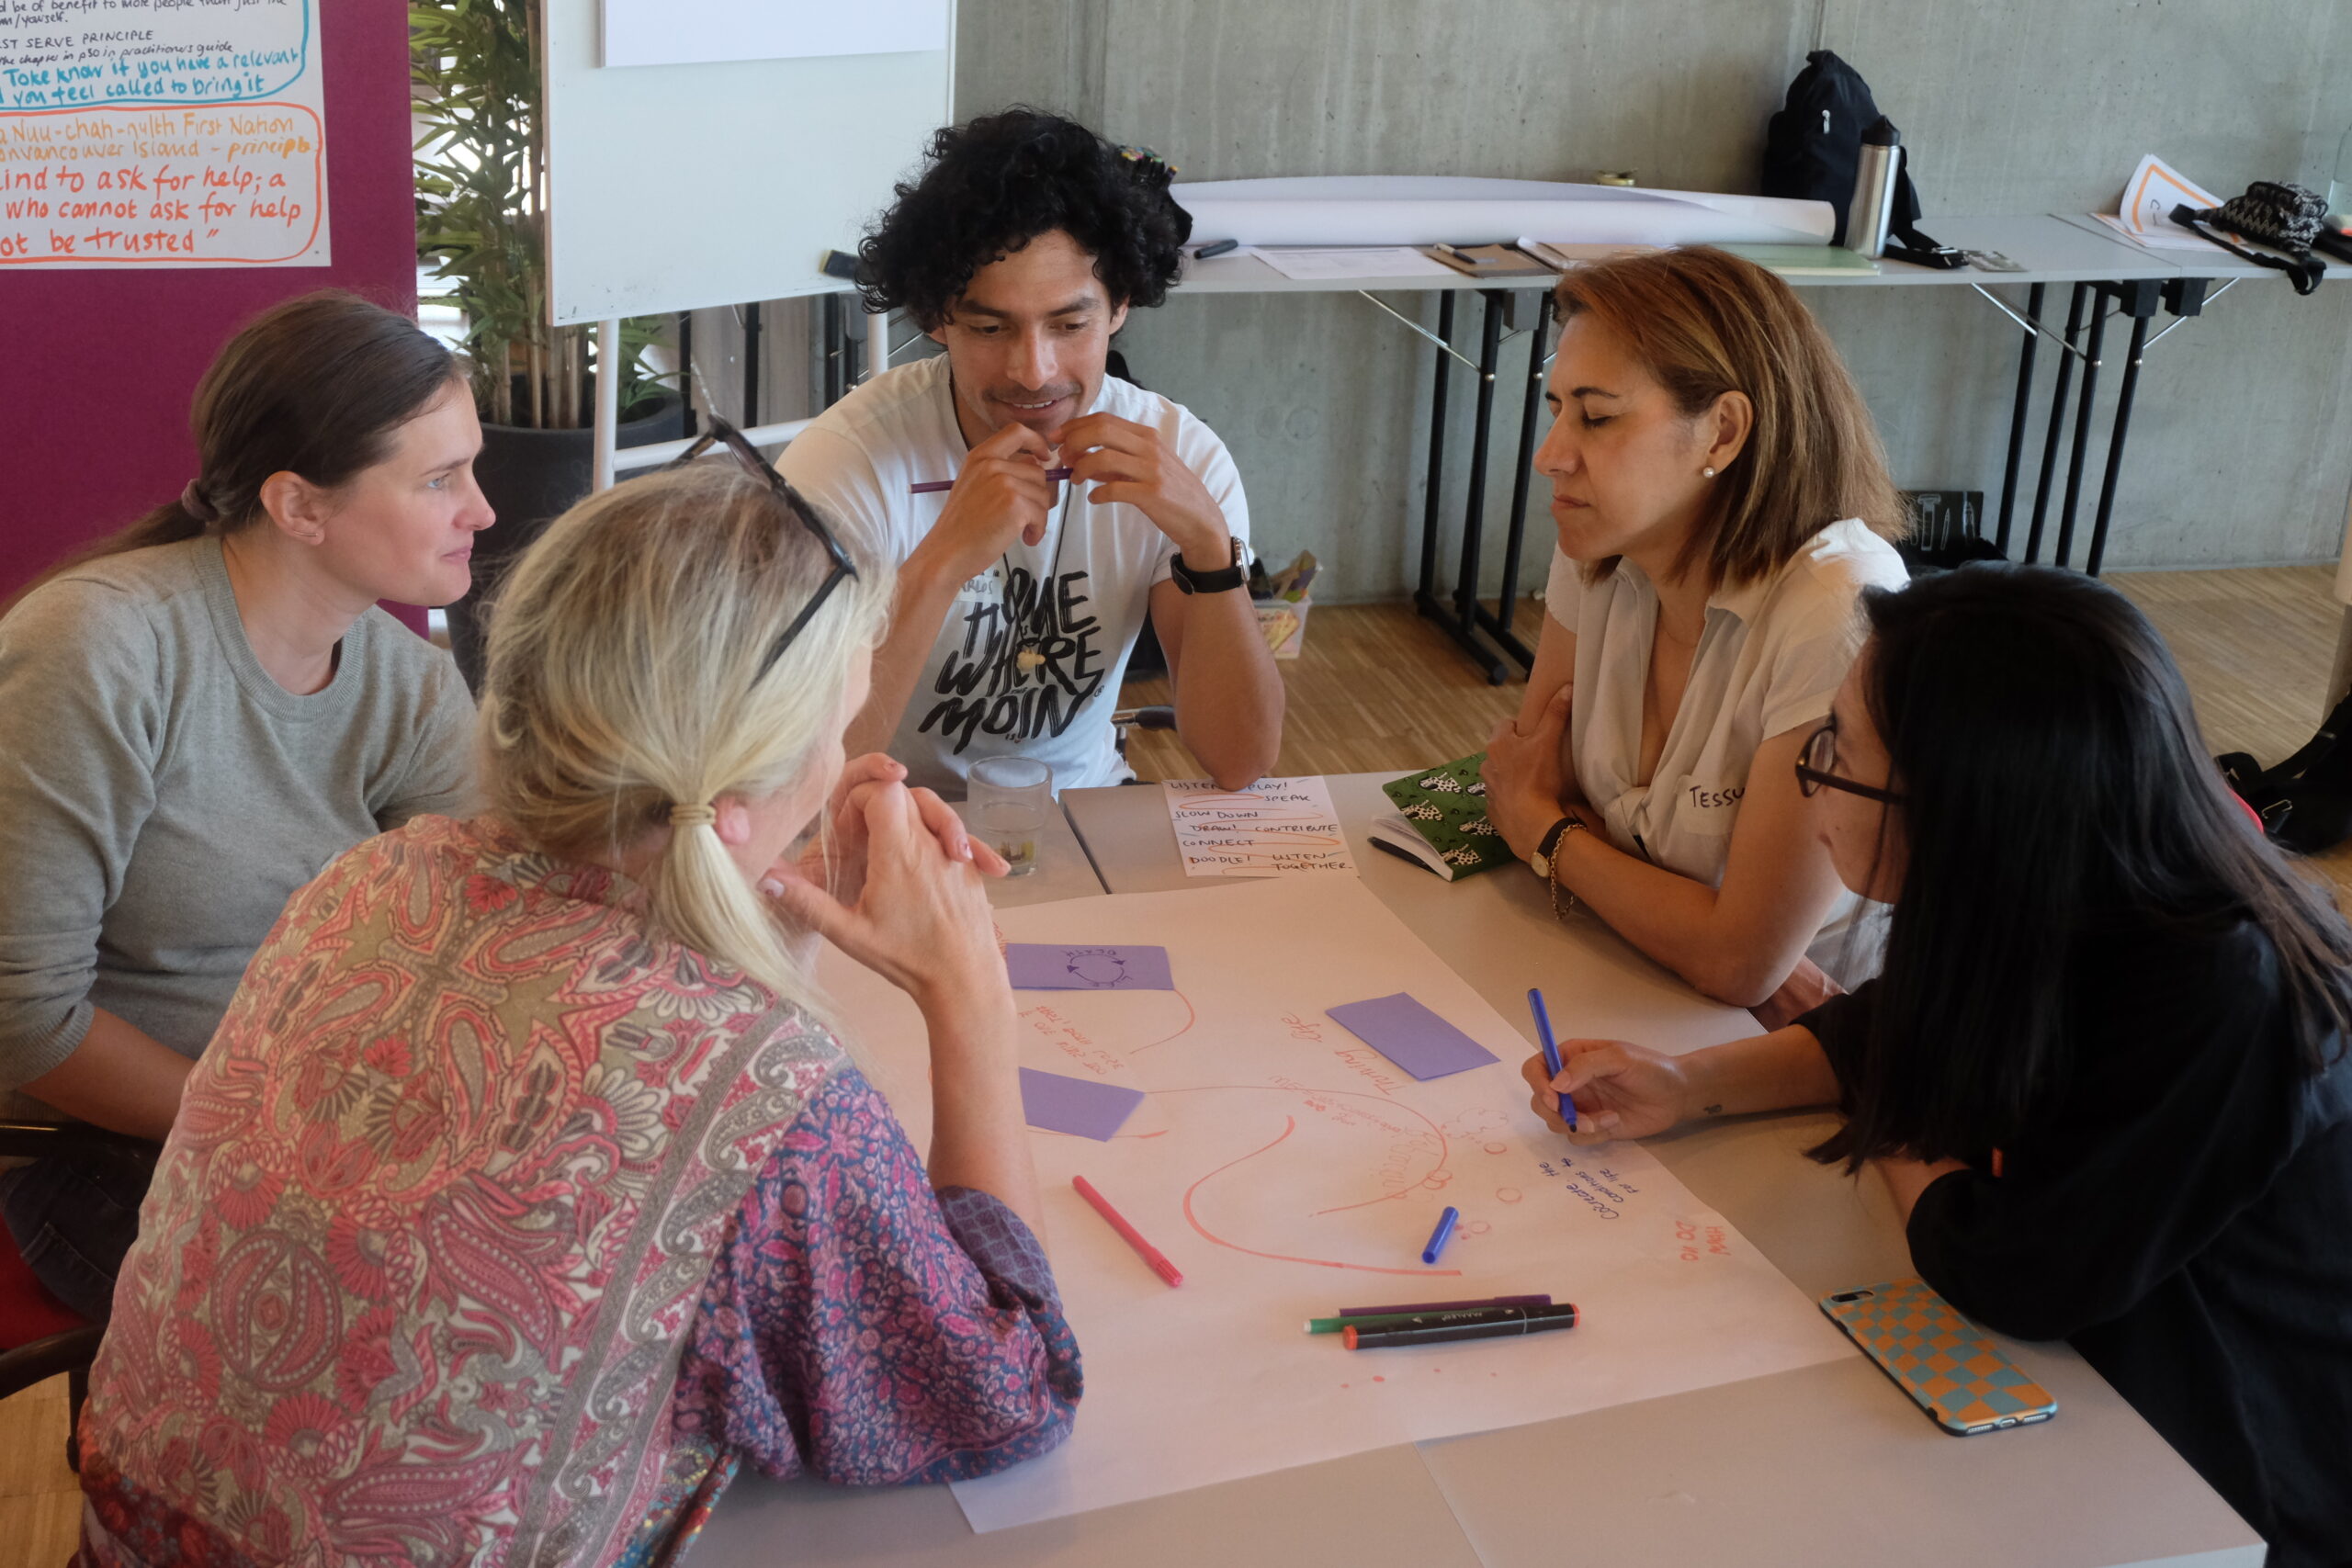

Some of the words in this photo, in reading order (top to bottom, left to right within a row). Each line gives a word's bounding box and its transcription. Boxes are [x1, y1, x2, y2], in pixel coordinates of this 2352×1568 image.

[12, 0, 27, 13] be
[31, 0, 44, 12] of
[51, 0, 97, 14] benefit
[103, 0, 116, 9] to
[26, 37, 74, 49] SERVE
[83, 30, 153, 44] PRINCIPLE
[197, 40, 233, 57] guide
[57, 65, 103, 84] know
[112, 58, 130, 76] if
[138, 59, 172, 79] you
[176, 56, 210, 71] have
[217, 56, 229, 69] a
[233, 48, 299, 67] relevant
[51, 85, 94, 106] feel
[106, 76, 164, 96] called
[172, 79, 187, 91] to
[193, 76, 242, 99] bring
[244, 72, 265, 92] it
[184, 112, 222, 137] First
[230, 114, 294, 136] Nation
[0, 166, 48, 191] ind
[56, 165, 85, 193] to
[97, 164, 147, 191] ask
[153, 164, 195, 200] for
[203, 164, 262, 196] help;
[268, 173, 286, 187] a
[6, 197, 50, 220] who
[59, 198, 138, 220] cannot
[150, 198, 189, 220] ask
[198, 190, 237, 224] for
[250, 195, 301, 229] help
[50, 228, 75, 254] be
[1255, 824, 1339, 832] CONTRIBUTE
[1183, 839, 1255, 847] CONNECT
